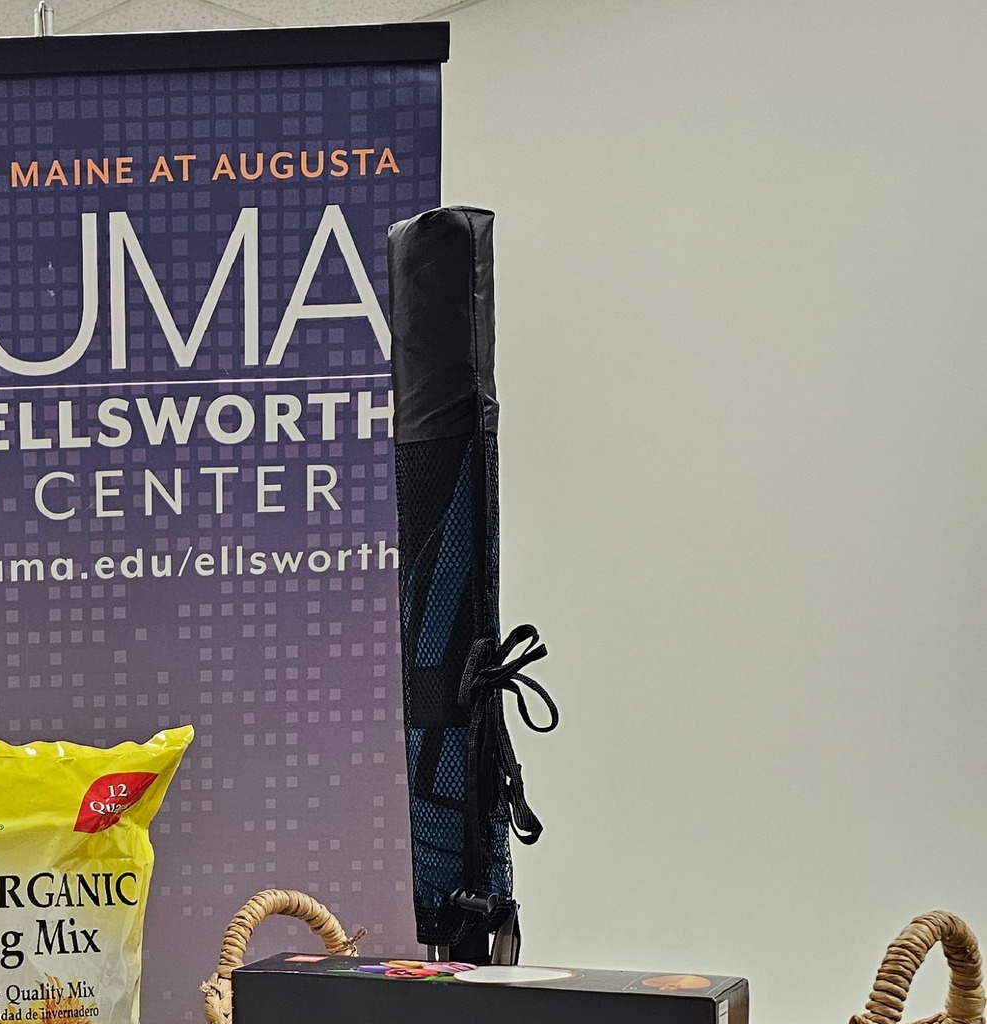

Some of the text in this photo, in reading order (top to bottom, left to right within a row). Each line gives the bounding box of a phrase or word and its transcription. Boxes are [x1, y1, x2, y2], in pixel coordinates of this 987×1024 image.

[11, 156, 134, 188] MAINE
[150, 154, 197, 182] AT
[212, 147, 401, 180] AUGUSTA
[34, 464, 342, 520] CENTER
[108, 783, 128, 798] 12
[34, 917, 101, 956] Mix
[5, 984, 64, 1006] Quality
[68, 981, 96, 999] Mix
[24, 1007, 39, 1021] de
[40, 1006, 100, 1021] invernadero
